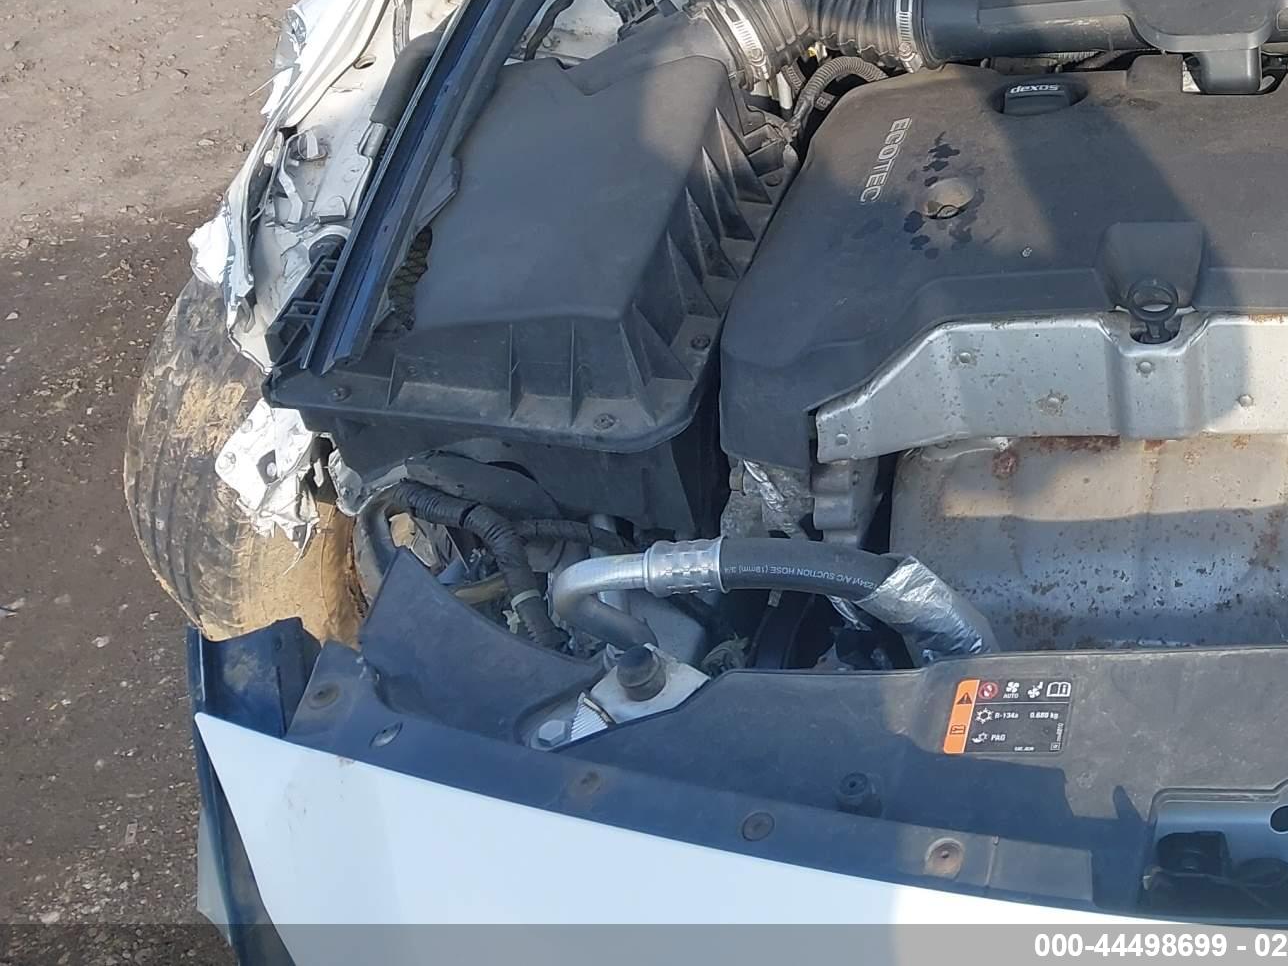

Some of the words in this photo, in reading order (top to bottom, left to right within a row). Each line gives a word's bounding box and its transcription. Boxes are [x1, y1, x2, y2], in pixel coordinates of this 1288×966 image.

[1010, 84, 1060, 94] dexos
[860, 117, 912, 203] ECOTEC
[770, 566, 795, 575] HOSE
[796, 568, 835, 580] SUCTION
[836, 574, 853, 584] A/C
[1050, 711, 1059, 720] kg
